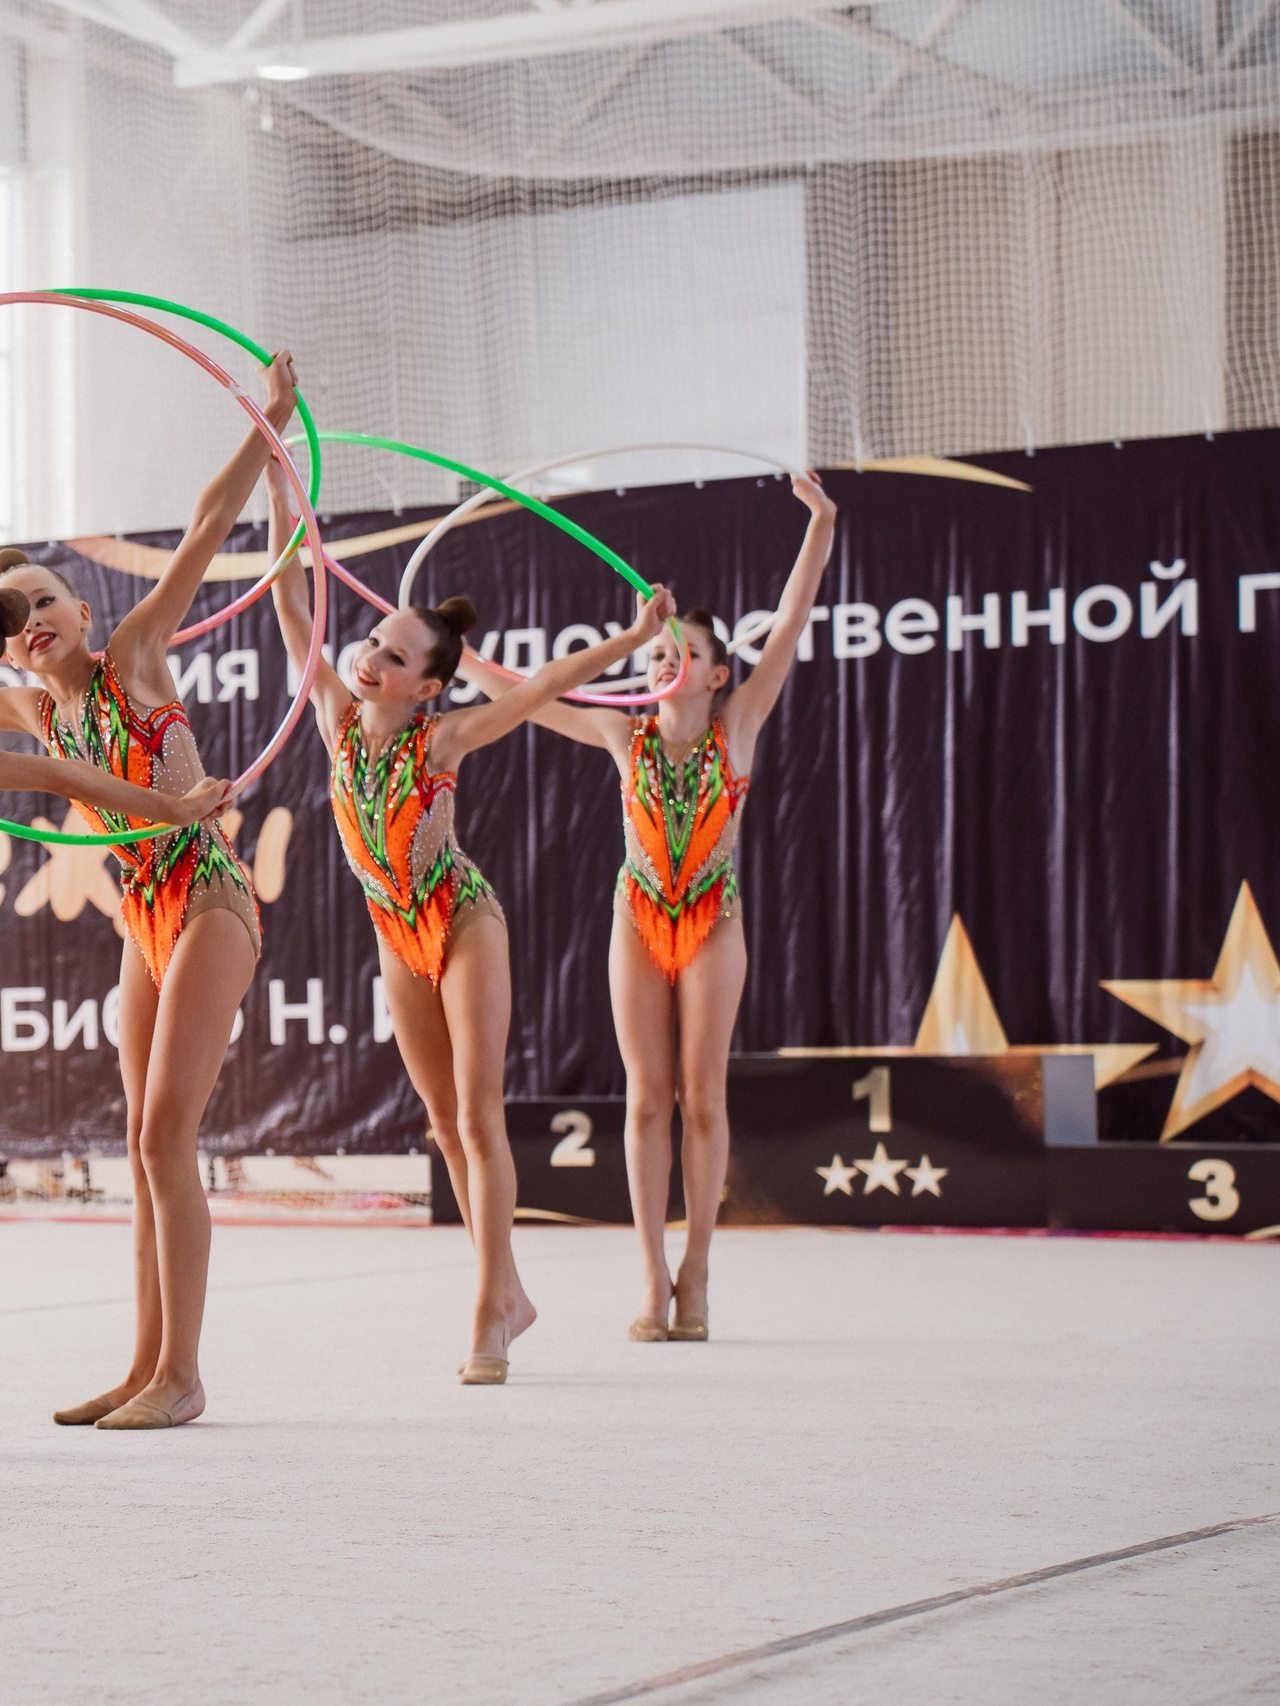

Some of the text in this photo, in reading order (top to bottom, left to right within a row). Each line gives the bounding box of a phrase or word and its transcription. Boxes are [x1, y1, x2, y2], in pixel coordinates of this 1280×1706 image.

[269, 978, 348, 1046] Н.
[852, 1066, 891, 1132] 1
[550, 1111, 595, 1167] 2
[1188, 1159, 1240, 1221] 3
